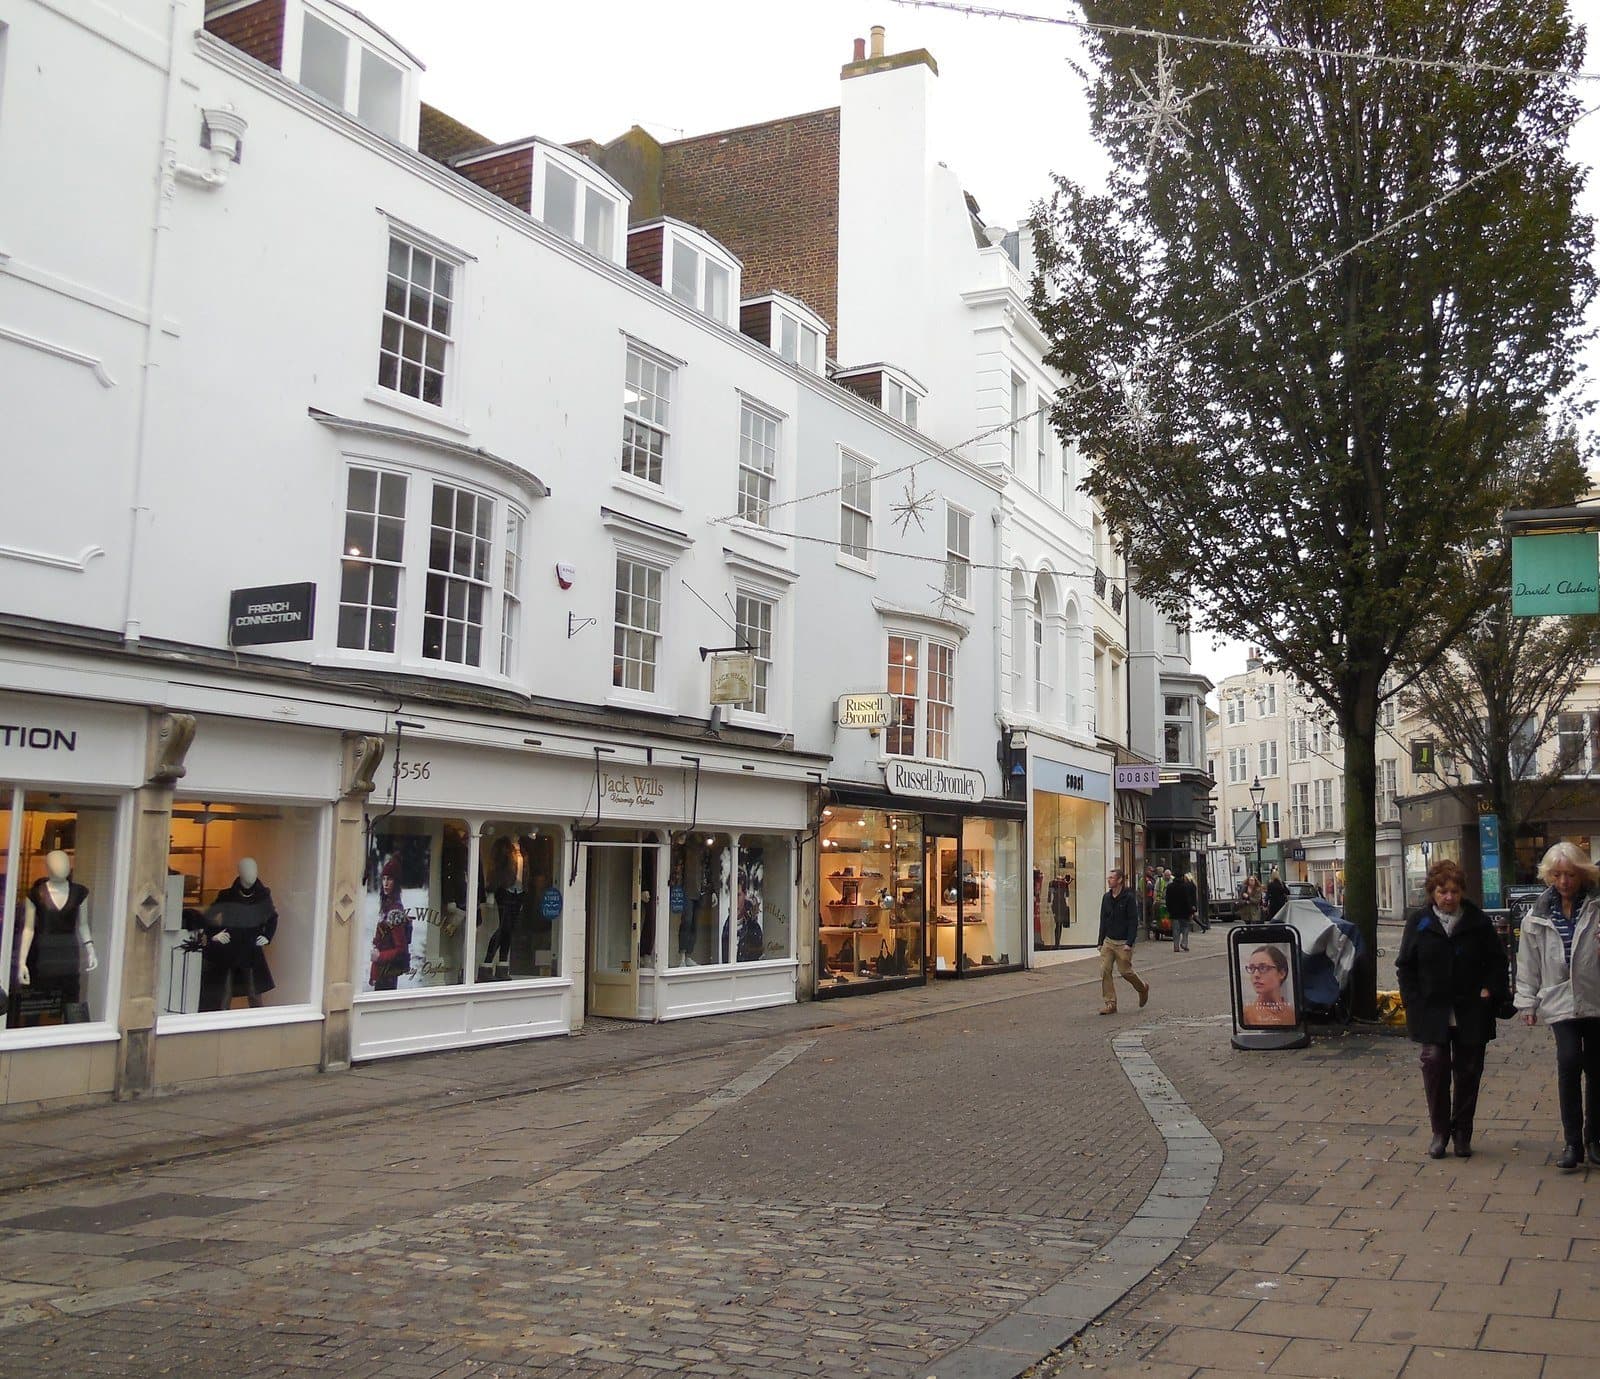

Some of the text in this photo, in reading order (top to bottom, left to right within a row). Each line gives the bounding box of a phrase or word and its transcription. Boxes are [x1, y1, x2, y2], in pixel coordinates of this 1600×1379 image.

[1515, 580, 1597, 597] David Clulow
[248, 602, 290, 615] FRENCH
[236, 611, 302, 627] CONNECTION
[846, 698, 884, 712] Russell
[0, 725, 77, 752] TION
[601, 773, 664, 798] Jack Wills
[895, 764, 933, 791] Russell
[1066, 773, 1084, 792] coast
[1119, 772, 1156, 784] coast
